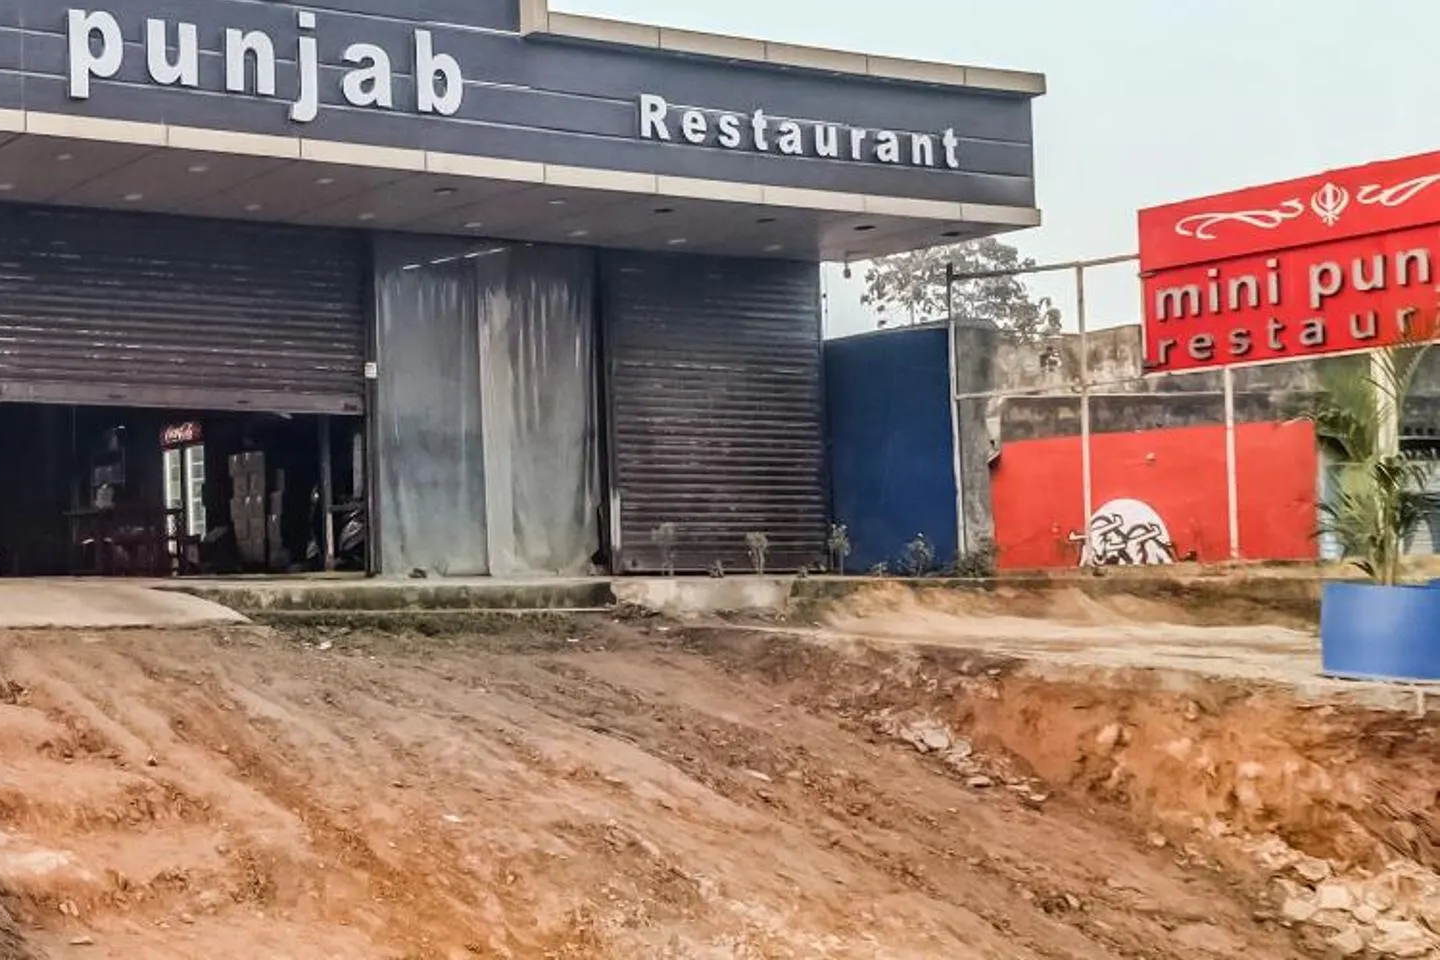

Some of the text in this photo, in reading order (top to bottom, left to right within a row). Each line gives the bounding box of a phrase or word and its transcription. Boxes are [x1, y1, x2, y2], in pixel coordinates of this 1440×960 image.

[67, 10, 464, 122] punjab
[639, 93, 960, 169] Restaurant
[1156, 246, 1440, 321] mini pun
[1158, 304, 1440, 365] restaur
